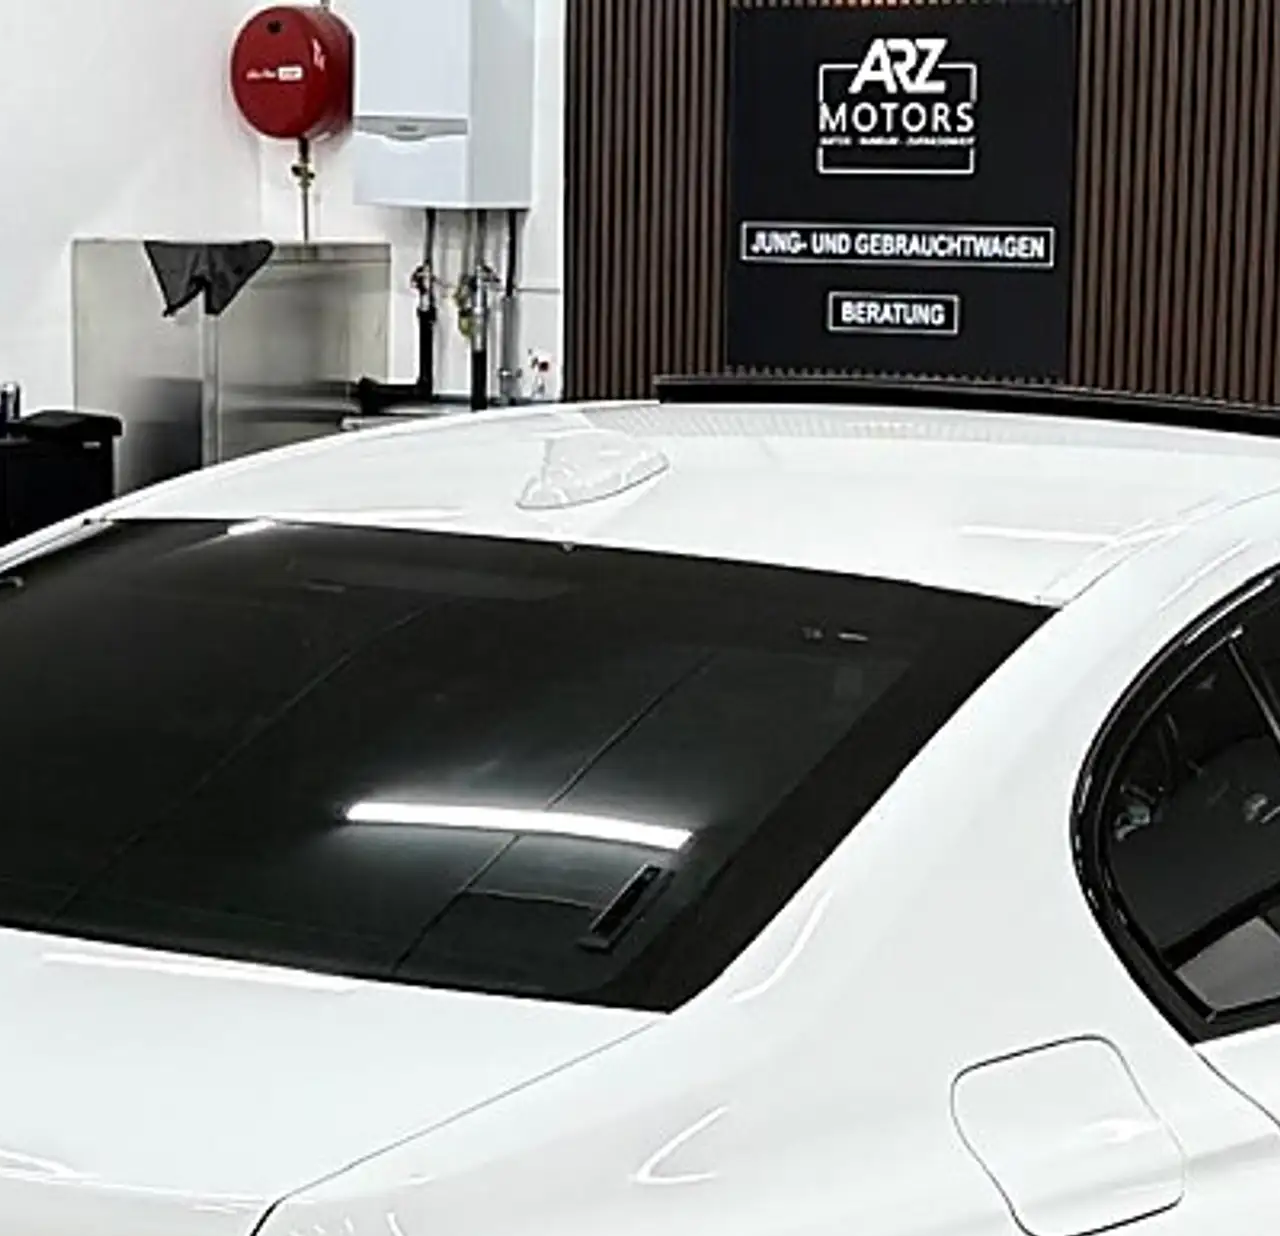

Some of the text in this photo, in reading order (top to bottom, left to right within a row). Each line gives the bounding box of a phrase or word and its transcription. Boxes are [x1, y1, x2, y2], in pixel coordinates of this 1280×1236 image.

[848, 38, 948, 94] ARZ
[819, 102, 975, 132] MOTORS
[750, 231, 1045, 259] JUNG- UND GEBRAUCHTWAGEN
[841, 301, 945, 326] BERATUNG
